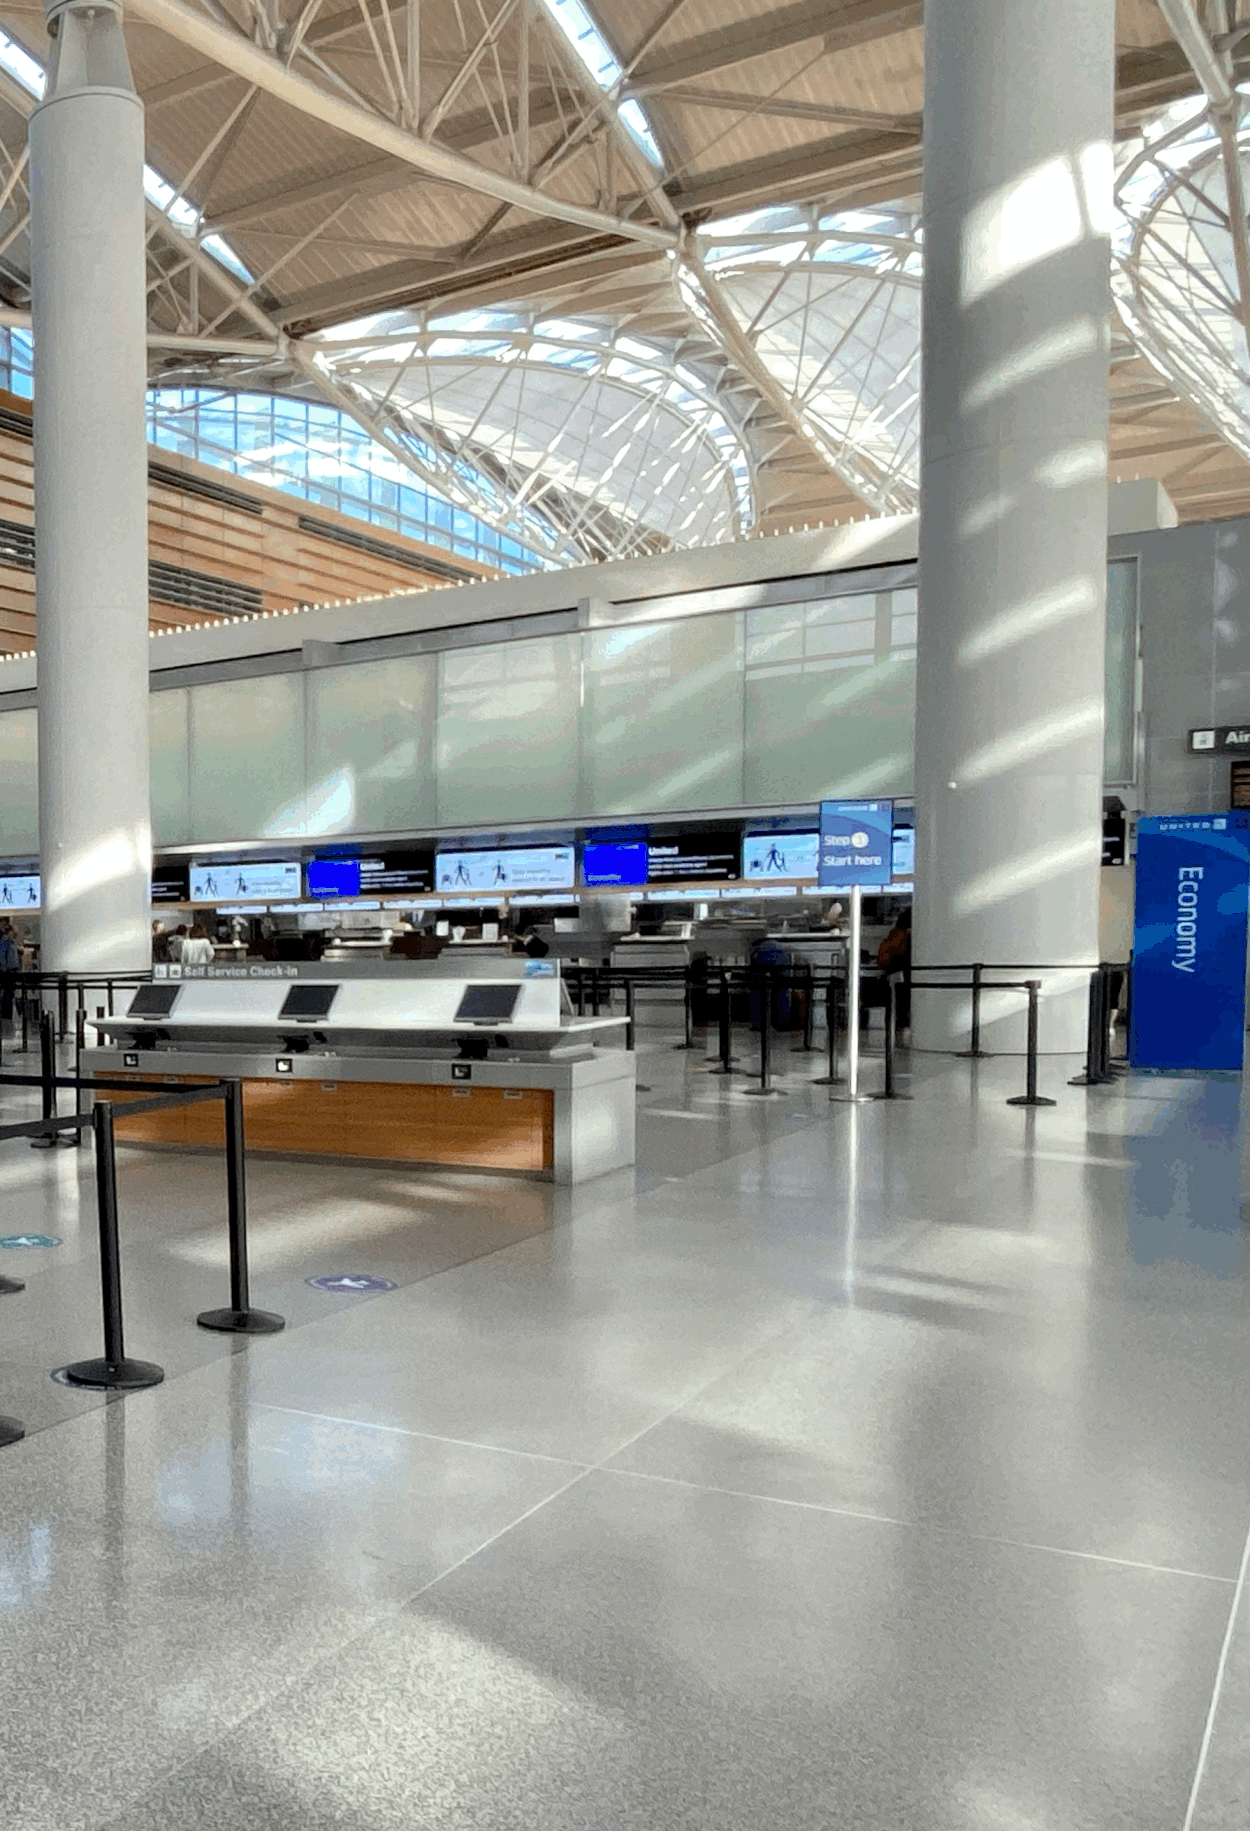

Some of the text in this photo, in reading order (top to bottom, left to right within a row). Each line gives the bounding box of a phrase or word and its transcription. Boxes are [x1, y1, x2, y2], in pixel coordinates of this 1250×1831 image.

[1159, 821, 1211, 830] UNITED
[824, 835, 851, 847] Step
[823, 855, 882, 866] Start here
[1171, 866, 1204, 973] Economy
[184, 965, 298, 977] Self Service Check-in
